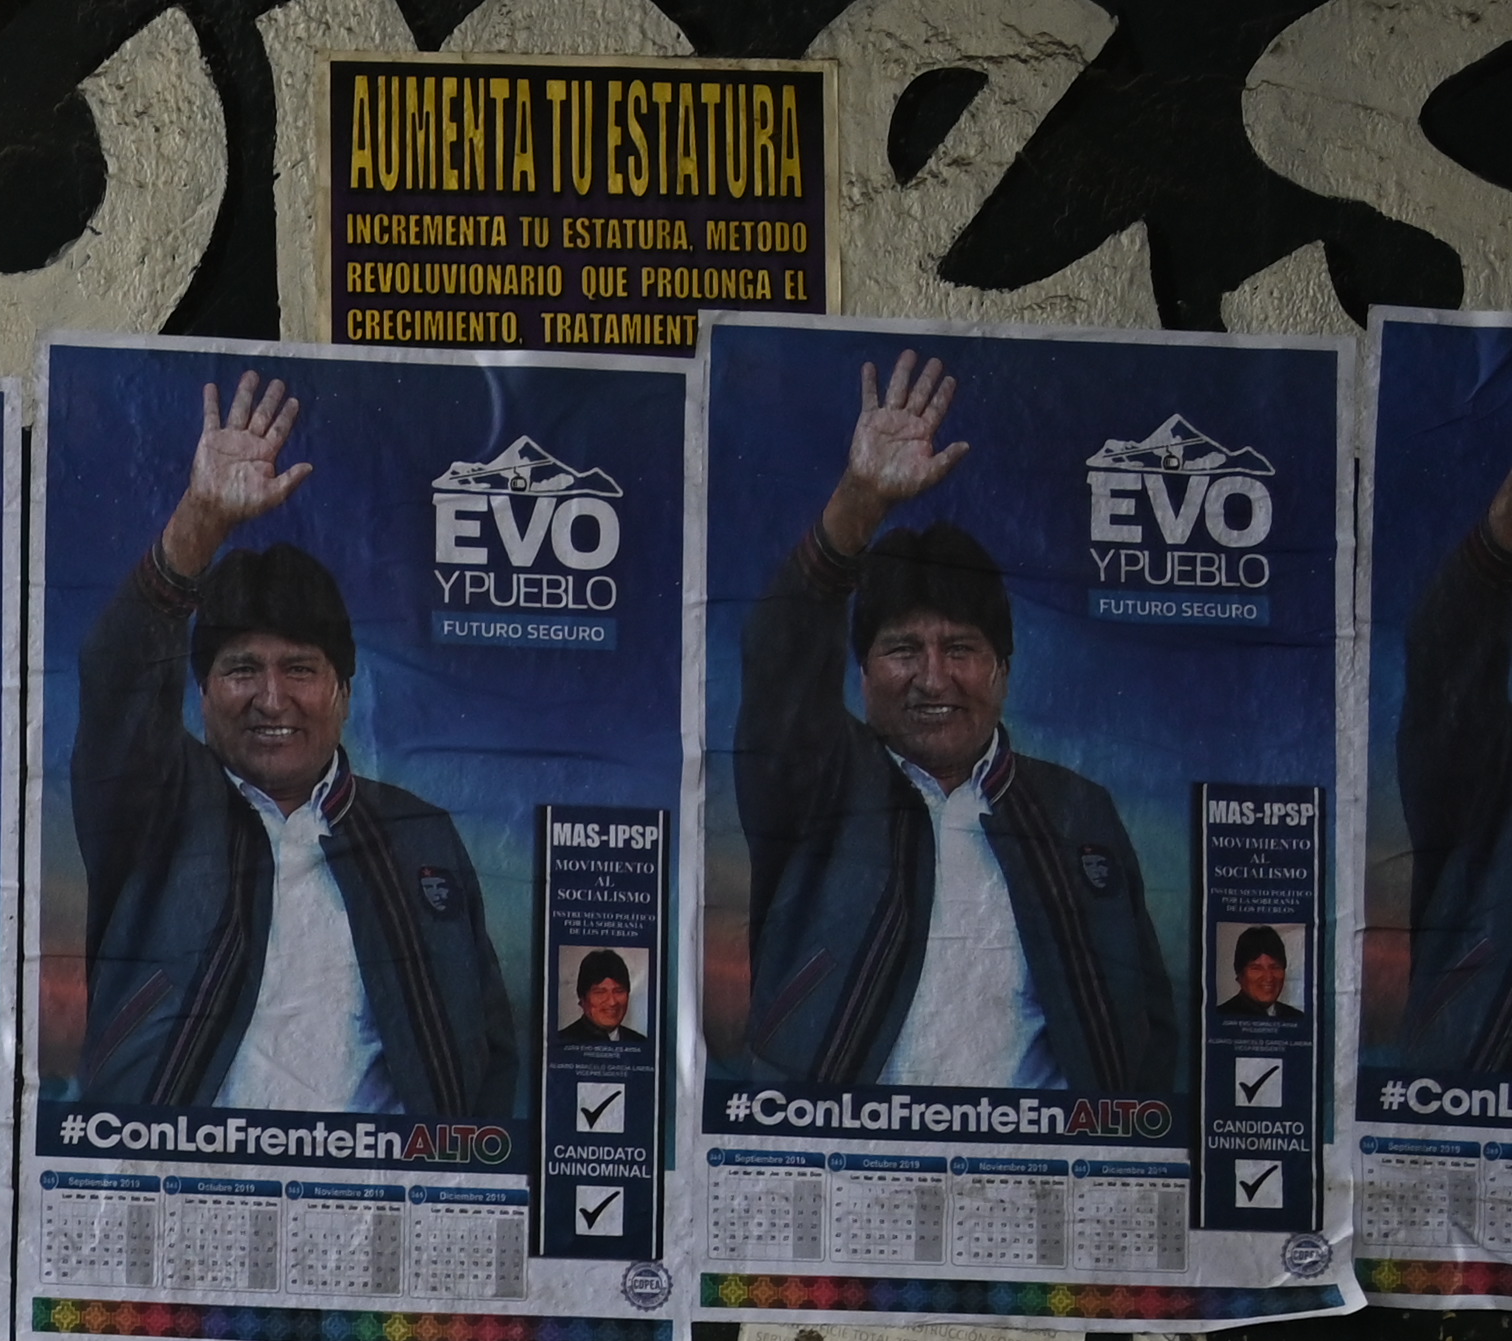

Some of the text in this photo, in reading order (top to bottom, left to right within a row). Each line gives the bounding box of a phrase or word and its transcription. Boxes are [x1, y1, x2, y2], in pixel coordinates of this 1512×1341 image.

[350, 75, 802, 198] AUMENTA TU ESTATURA
[346, 213, 808, 253] INCREMENTA TU ESTATURA, METODO
[346, 262, 808, 300] REVOLUVIONARIO QUE PROLONGA EL
[432, 493, 619, 569] EVO
[1087, 471, 1271, 547] EVO
[59, 1112, 512, 1164] #ConLaFrenteEnALTO
[726, 1090, 1172, 1139] #ConLaFrenteEnALTO
